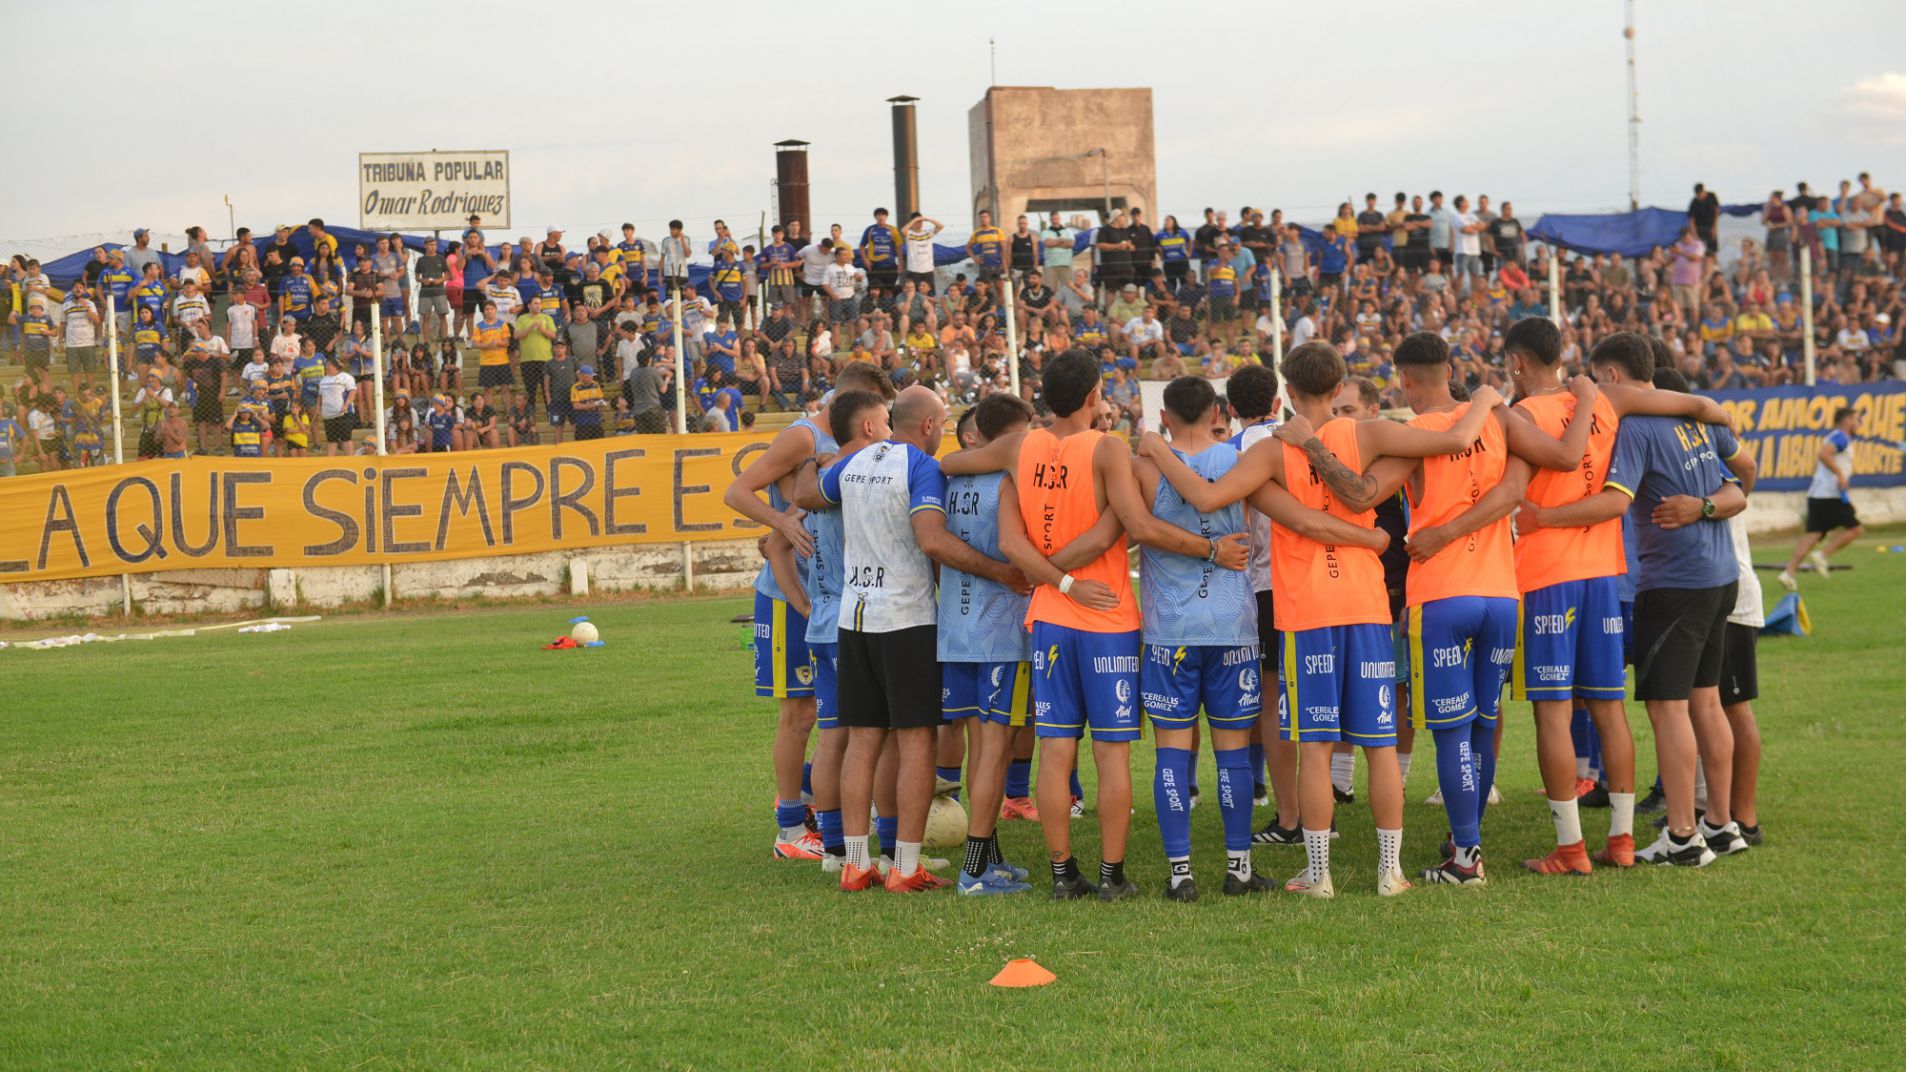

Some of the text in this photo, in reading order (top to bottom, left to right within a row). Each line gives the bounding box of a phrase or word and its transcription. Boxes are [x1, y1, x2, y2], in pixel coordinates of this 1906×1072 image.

[363, 160, 504, 182] TRIBUNA POPULAR
[364, 189, 417, 215] Omar
[1720, 399, 1757, 433] OR
[844, 474, 867, 484] GEPE
[0, 484, 90, 572] A
[105, 471, 274, 563] QUE
[1093, 655, 1140, 673] UNLIMITED
[1305, 654, 1396, 679] SPEED UNLIMITE
[1433, 645, 1462, 668] SPEED
[1461, 763, 1475, 792] SPORT
[1166, 788, 1184, 812] SPORT
[1222, 784, 1235, 809] SPORT
